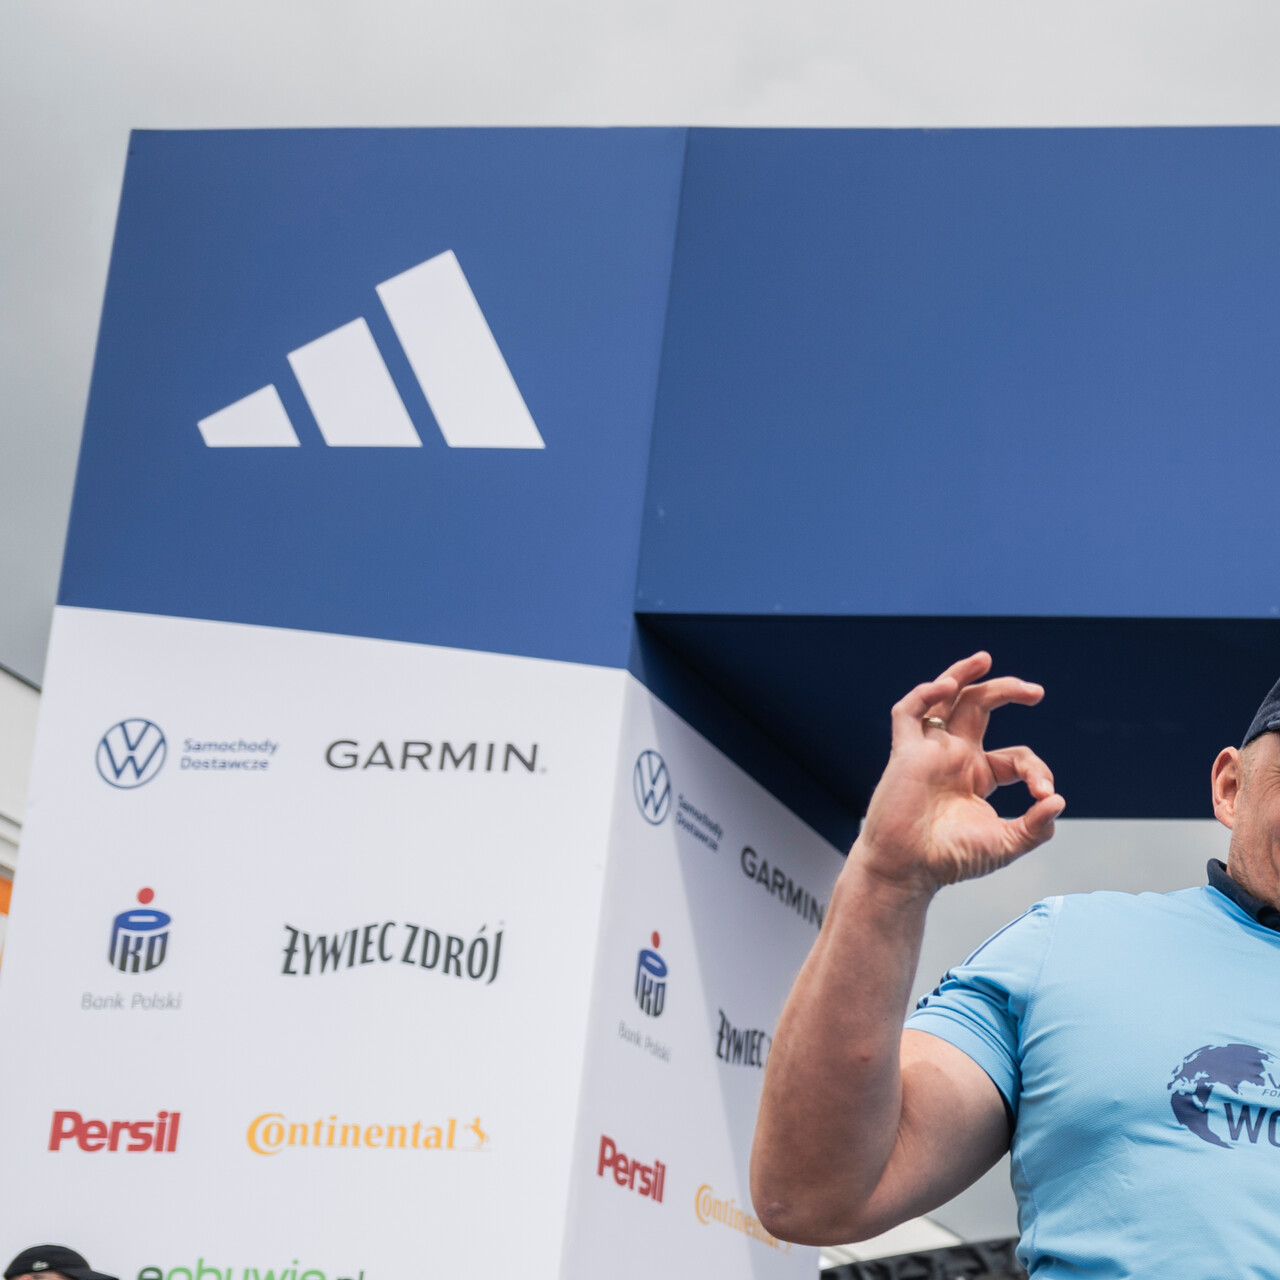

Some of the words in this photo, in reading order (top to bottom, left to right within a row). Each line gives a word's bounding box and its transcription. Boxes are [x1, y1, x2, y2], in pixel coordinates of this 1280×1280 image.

[180, 755, 270, 772] Dostawcze
[182, 737, 279, 758] Samochody
[324, 738, 540, 774] GARMIN
[281, 920, 398, 977] ŻYWIEC
[401, 921, 505, 986] ZDRÓJ
[80, 993, 124, 1011] Bank
[130, 992, 182, 1011] Polski
[716, 1009, 765, 1069] ŻYWIEC
[47, 1110, 182, 1154] Persil
[245, 1112, 457, 1156] Continental
[597, 1133, 667, 1203] Persil
